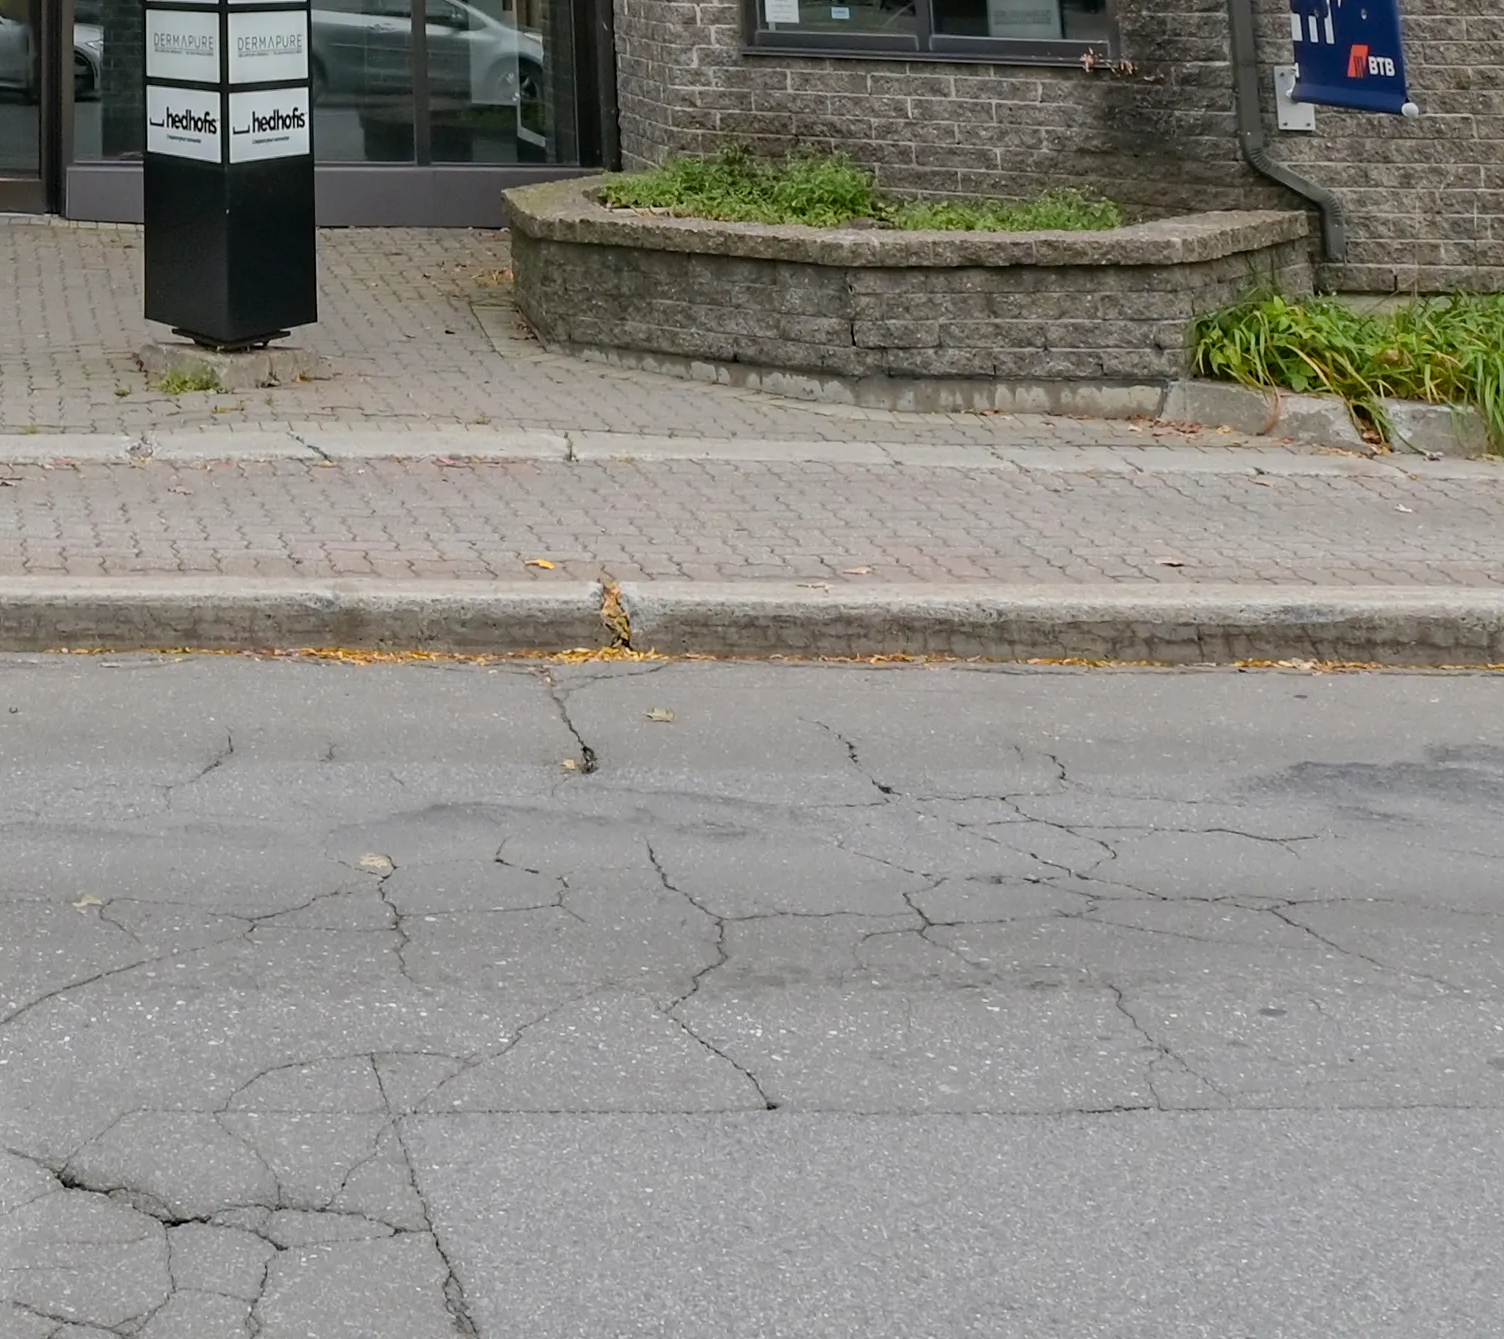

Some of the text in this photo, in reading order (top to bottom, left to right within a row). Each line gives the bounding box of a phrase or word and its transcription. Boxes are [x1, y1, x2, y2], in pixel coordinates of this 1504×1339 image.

[153, 32, 214, 51] DERMAPURE
[237, 34, 303, 51] DERMAPURE
[1368, 56, 1396, 77] BTB
[166, 106, 217, 134] hedhofis
[252, 106, 306, 133] hedhofis
